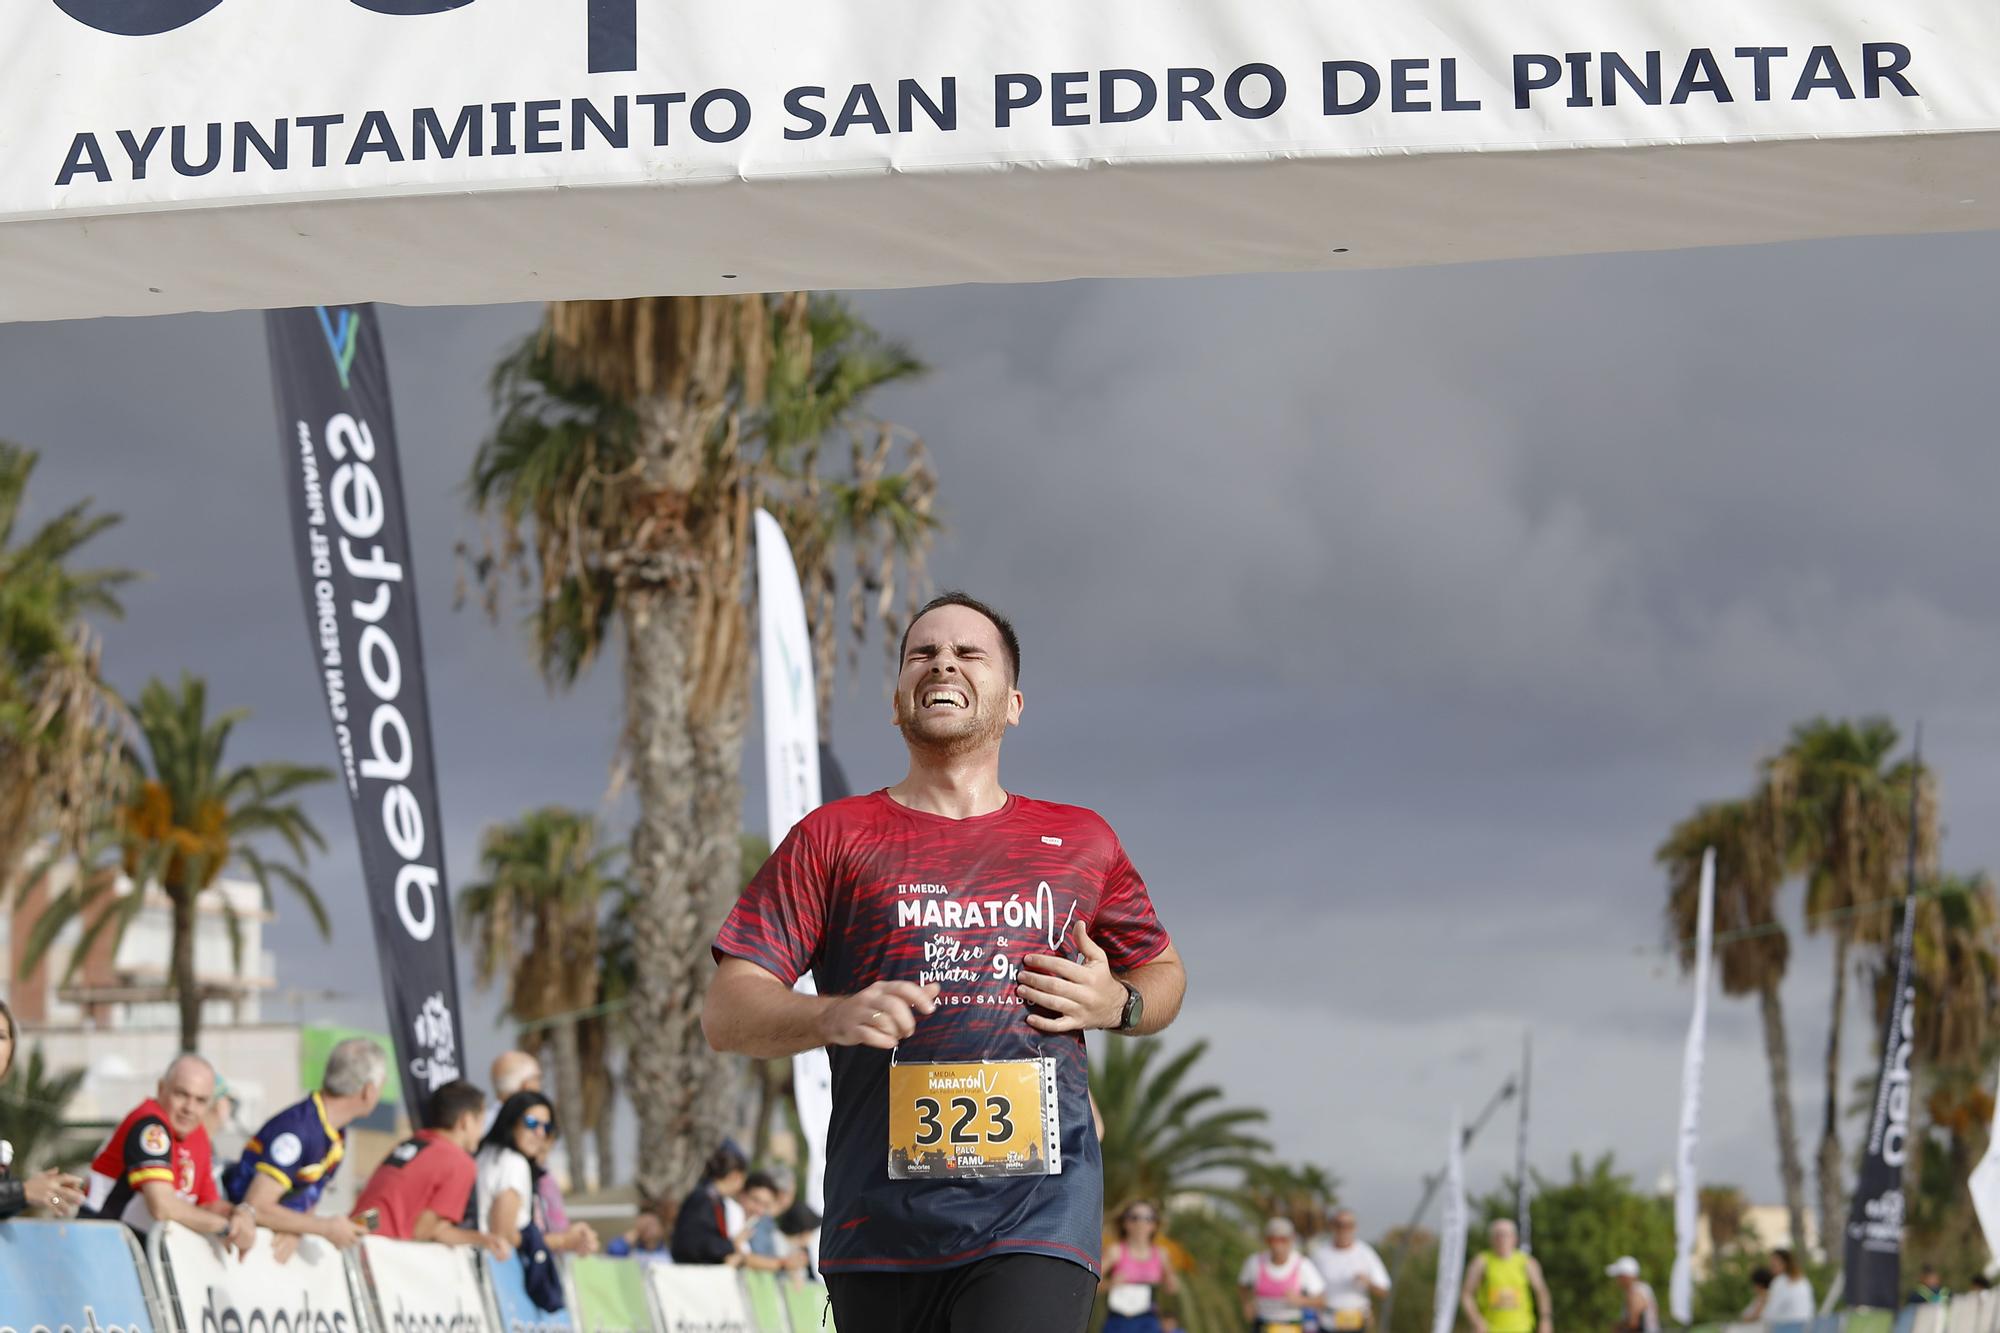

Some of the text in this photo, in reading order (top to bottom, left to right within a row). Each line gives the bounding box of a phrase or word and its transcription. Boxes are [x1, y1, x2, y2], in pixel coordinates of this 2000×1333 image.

[54, 42, 1920, 186] AYUNTAMIENTO SAN PEDRO DEL PINATAR
[898, 884, 949, 895] II MEDIA
[898, 882, 1049, 930] MARATÓN
[996, 936, 1009, 947] &
[933, 995, 971, 1006] AISO
[929, 1069, 983, 1089] MARATÓN
[914, 1095, 1015, 1145] 323
[955, 1145, 976, 1154] PALO
[957, 1155, 984, 1166] FAMU
